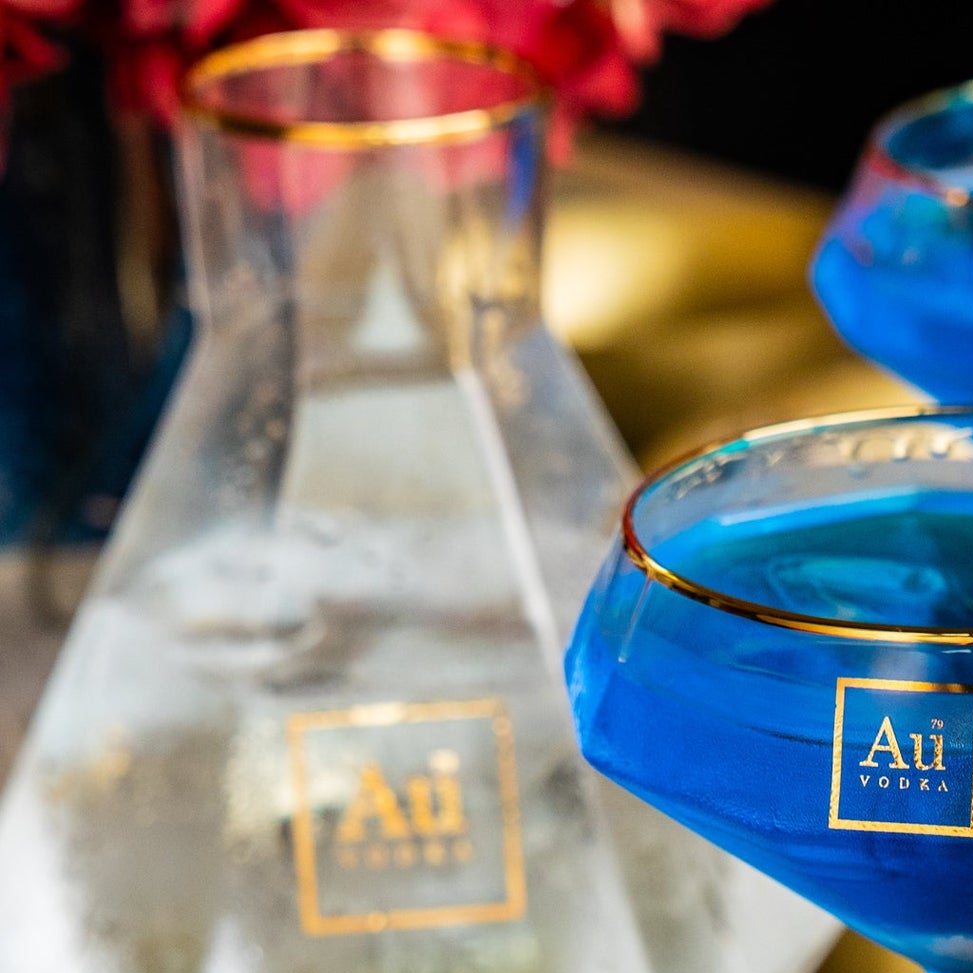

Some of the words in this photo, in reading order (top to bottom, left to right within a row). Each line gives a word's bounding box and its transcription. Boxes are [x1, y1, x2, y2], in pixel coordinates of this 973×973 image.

[931, 719, 945, 730] 79
[859, 716, 946, 771] Au
[336, 760, 468, 838] Au
[860, 775, 949, 792] VODKA
